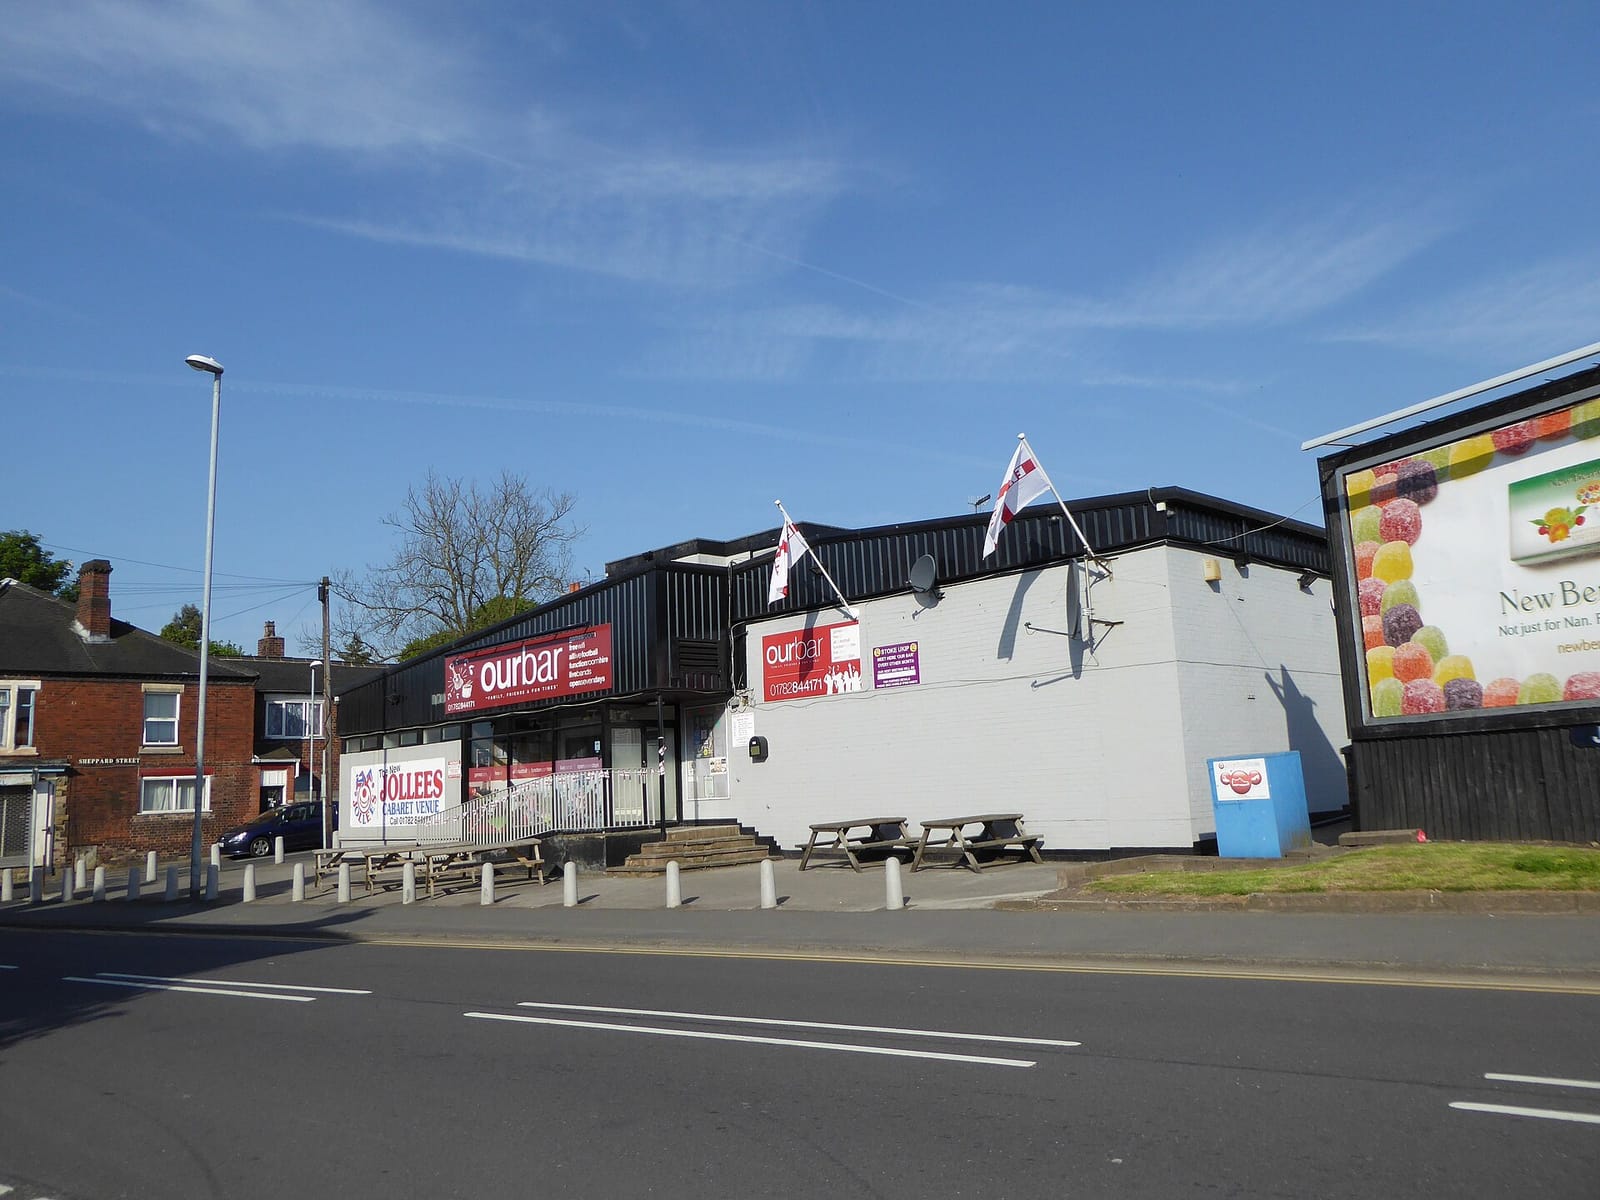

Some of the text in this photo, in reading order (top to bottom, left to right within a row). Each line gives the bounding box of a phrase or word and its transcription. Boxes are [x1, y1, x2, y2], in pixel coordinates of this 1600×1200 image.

[1499, 580, 1600, 615] New Be
[1498, 624, 1518, 636] Not
[1520, 621, 1541, 637] just
[1544, 618, 1560, 631] for
[1564, 616, 1592, 628] Nan.
[766, 636, 824, 665] ourbar
[480, 644, 563, 692] ourbar
[770, 678, 822, 696] 01782844171
[390, 765, 400, 774] New
[379, 769, 443, 802] JOLLEES
[382, 800, 439, 816] CABARET VENUE
